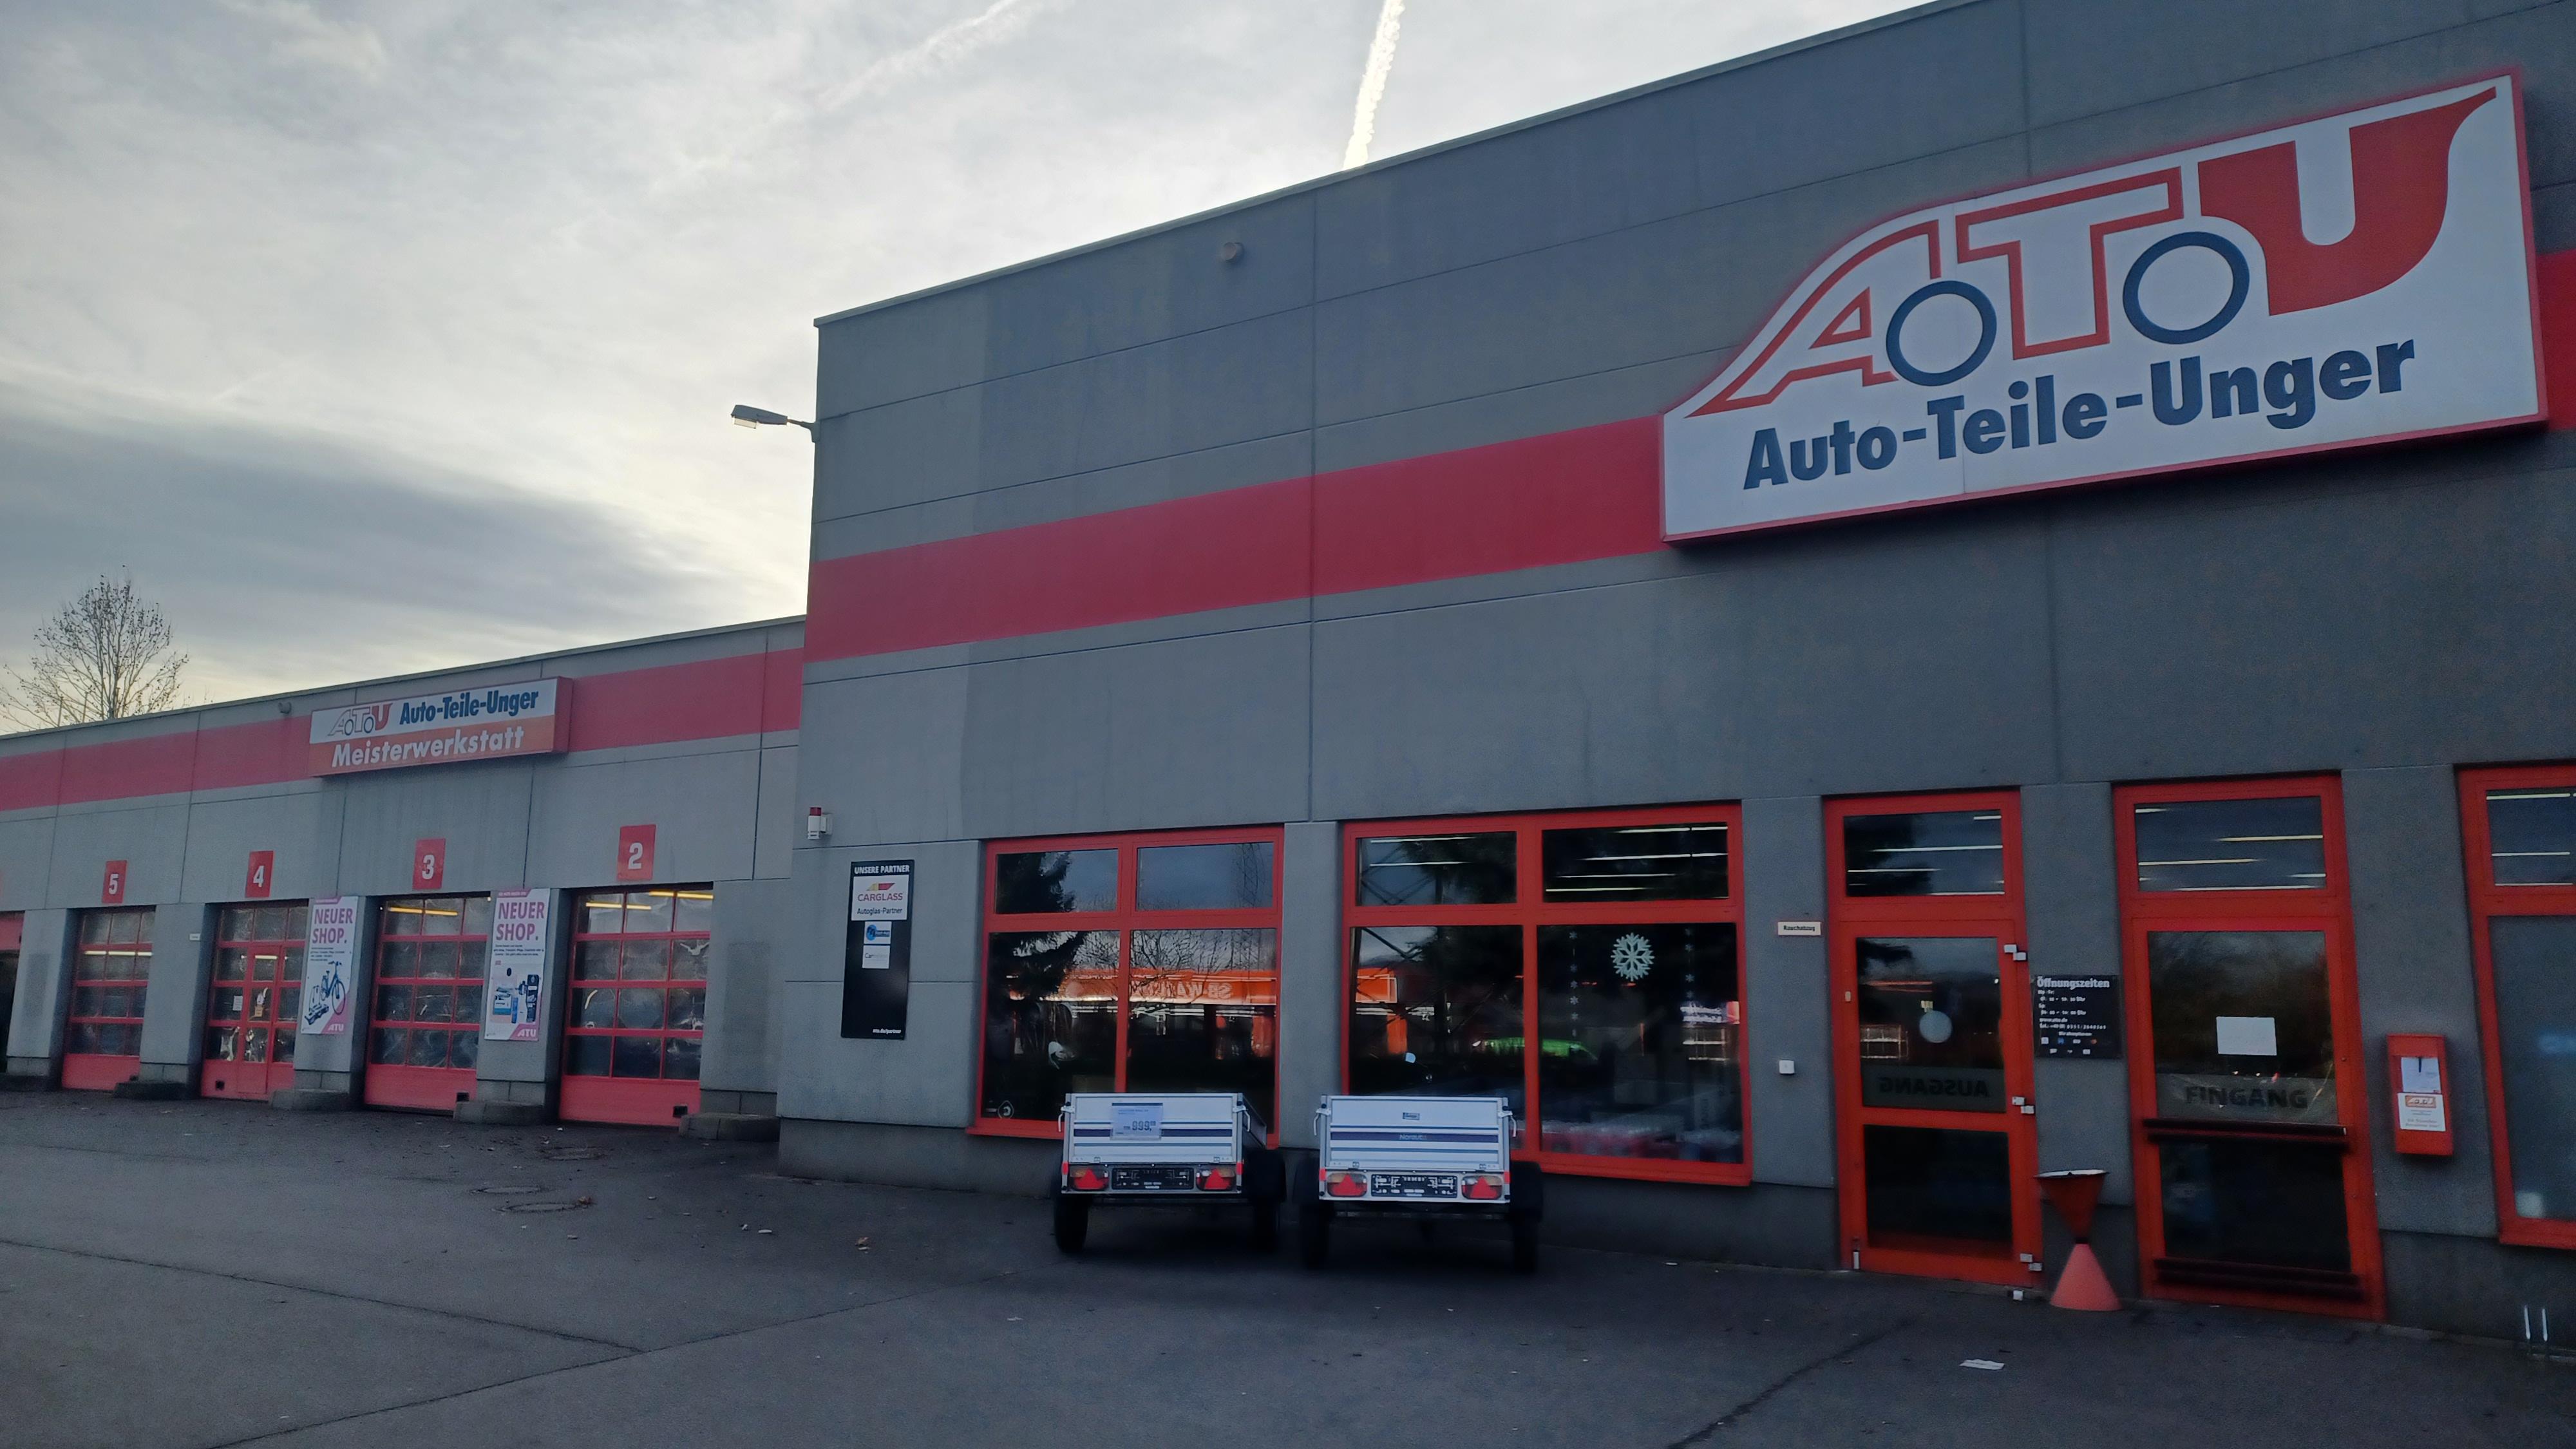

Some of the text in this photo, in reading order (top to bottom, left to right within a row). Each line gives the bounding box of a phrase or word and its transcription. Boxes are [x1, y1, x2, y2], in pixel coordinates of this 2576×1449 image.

[1743, 339, 2415, 489] Auto-Teile-Unger
[399, 690, 538, 725] Auto-Teile-Unger
[332, 726, 524, 768] Meisterwerkstatt
[628, 842, 643, 869] 2
[422, 855, 435, 880] 3
[880, 864, 909, 873] PARTNER
[108, 873, 119, 895] 5
[253, 866, 264, 887] 4
[857, 893, 903, 902] CARGLASS
[314, 908, 353, 924] NEUER
[498, 902, 545, 919] NEUER
[857, 907, 902, 916] Autoglas-Partner
[312, 928, 347, 943] SHOP.
[496, 923, 538, 940] SHOP.
[2037, 976, 2110, 990] Öffnungszeiten
[327, 1023, 345, 1032] ATU
[517, 1028, 536, 1037] ATU
